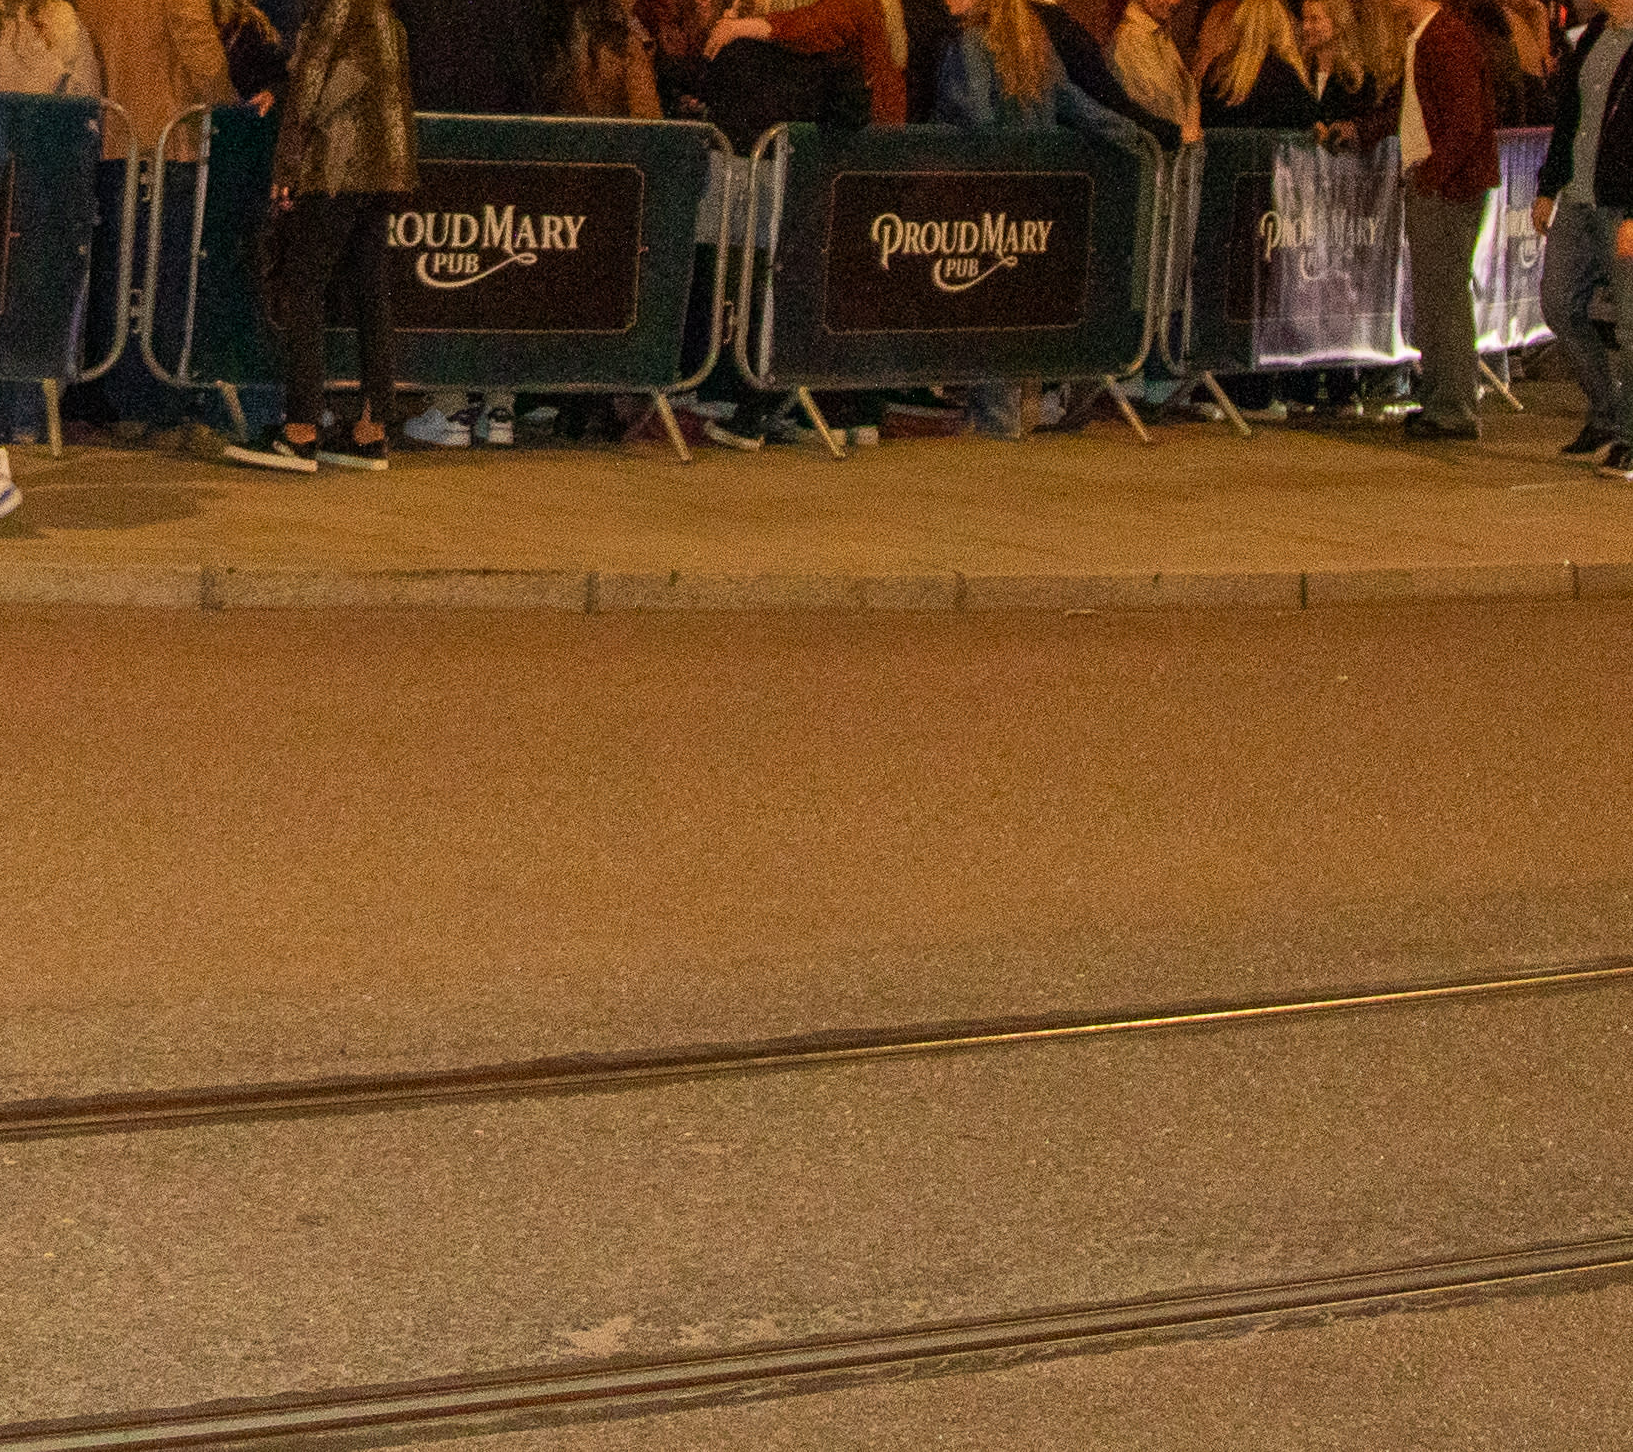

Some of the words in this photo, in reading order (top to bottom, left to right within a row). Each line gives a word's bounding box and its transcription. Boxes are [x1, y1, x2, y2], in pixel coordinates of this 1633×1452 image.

[482, 203, 587, 251] MARY
[870, 211, 980, 271] PROUD
[981, 211, 1055, 255] MARY
[433, 252, 481, 274] PUB
[946, 258, 980, 279] PUB
